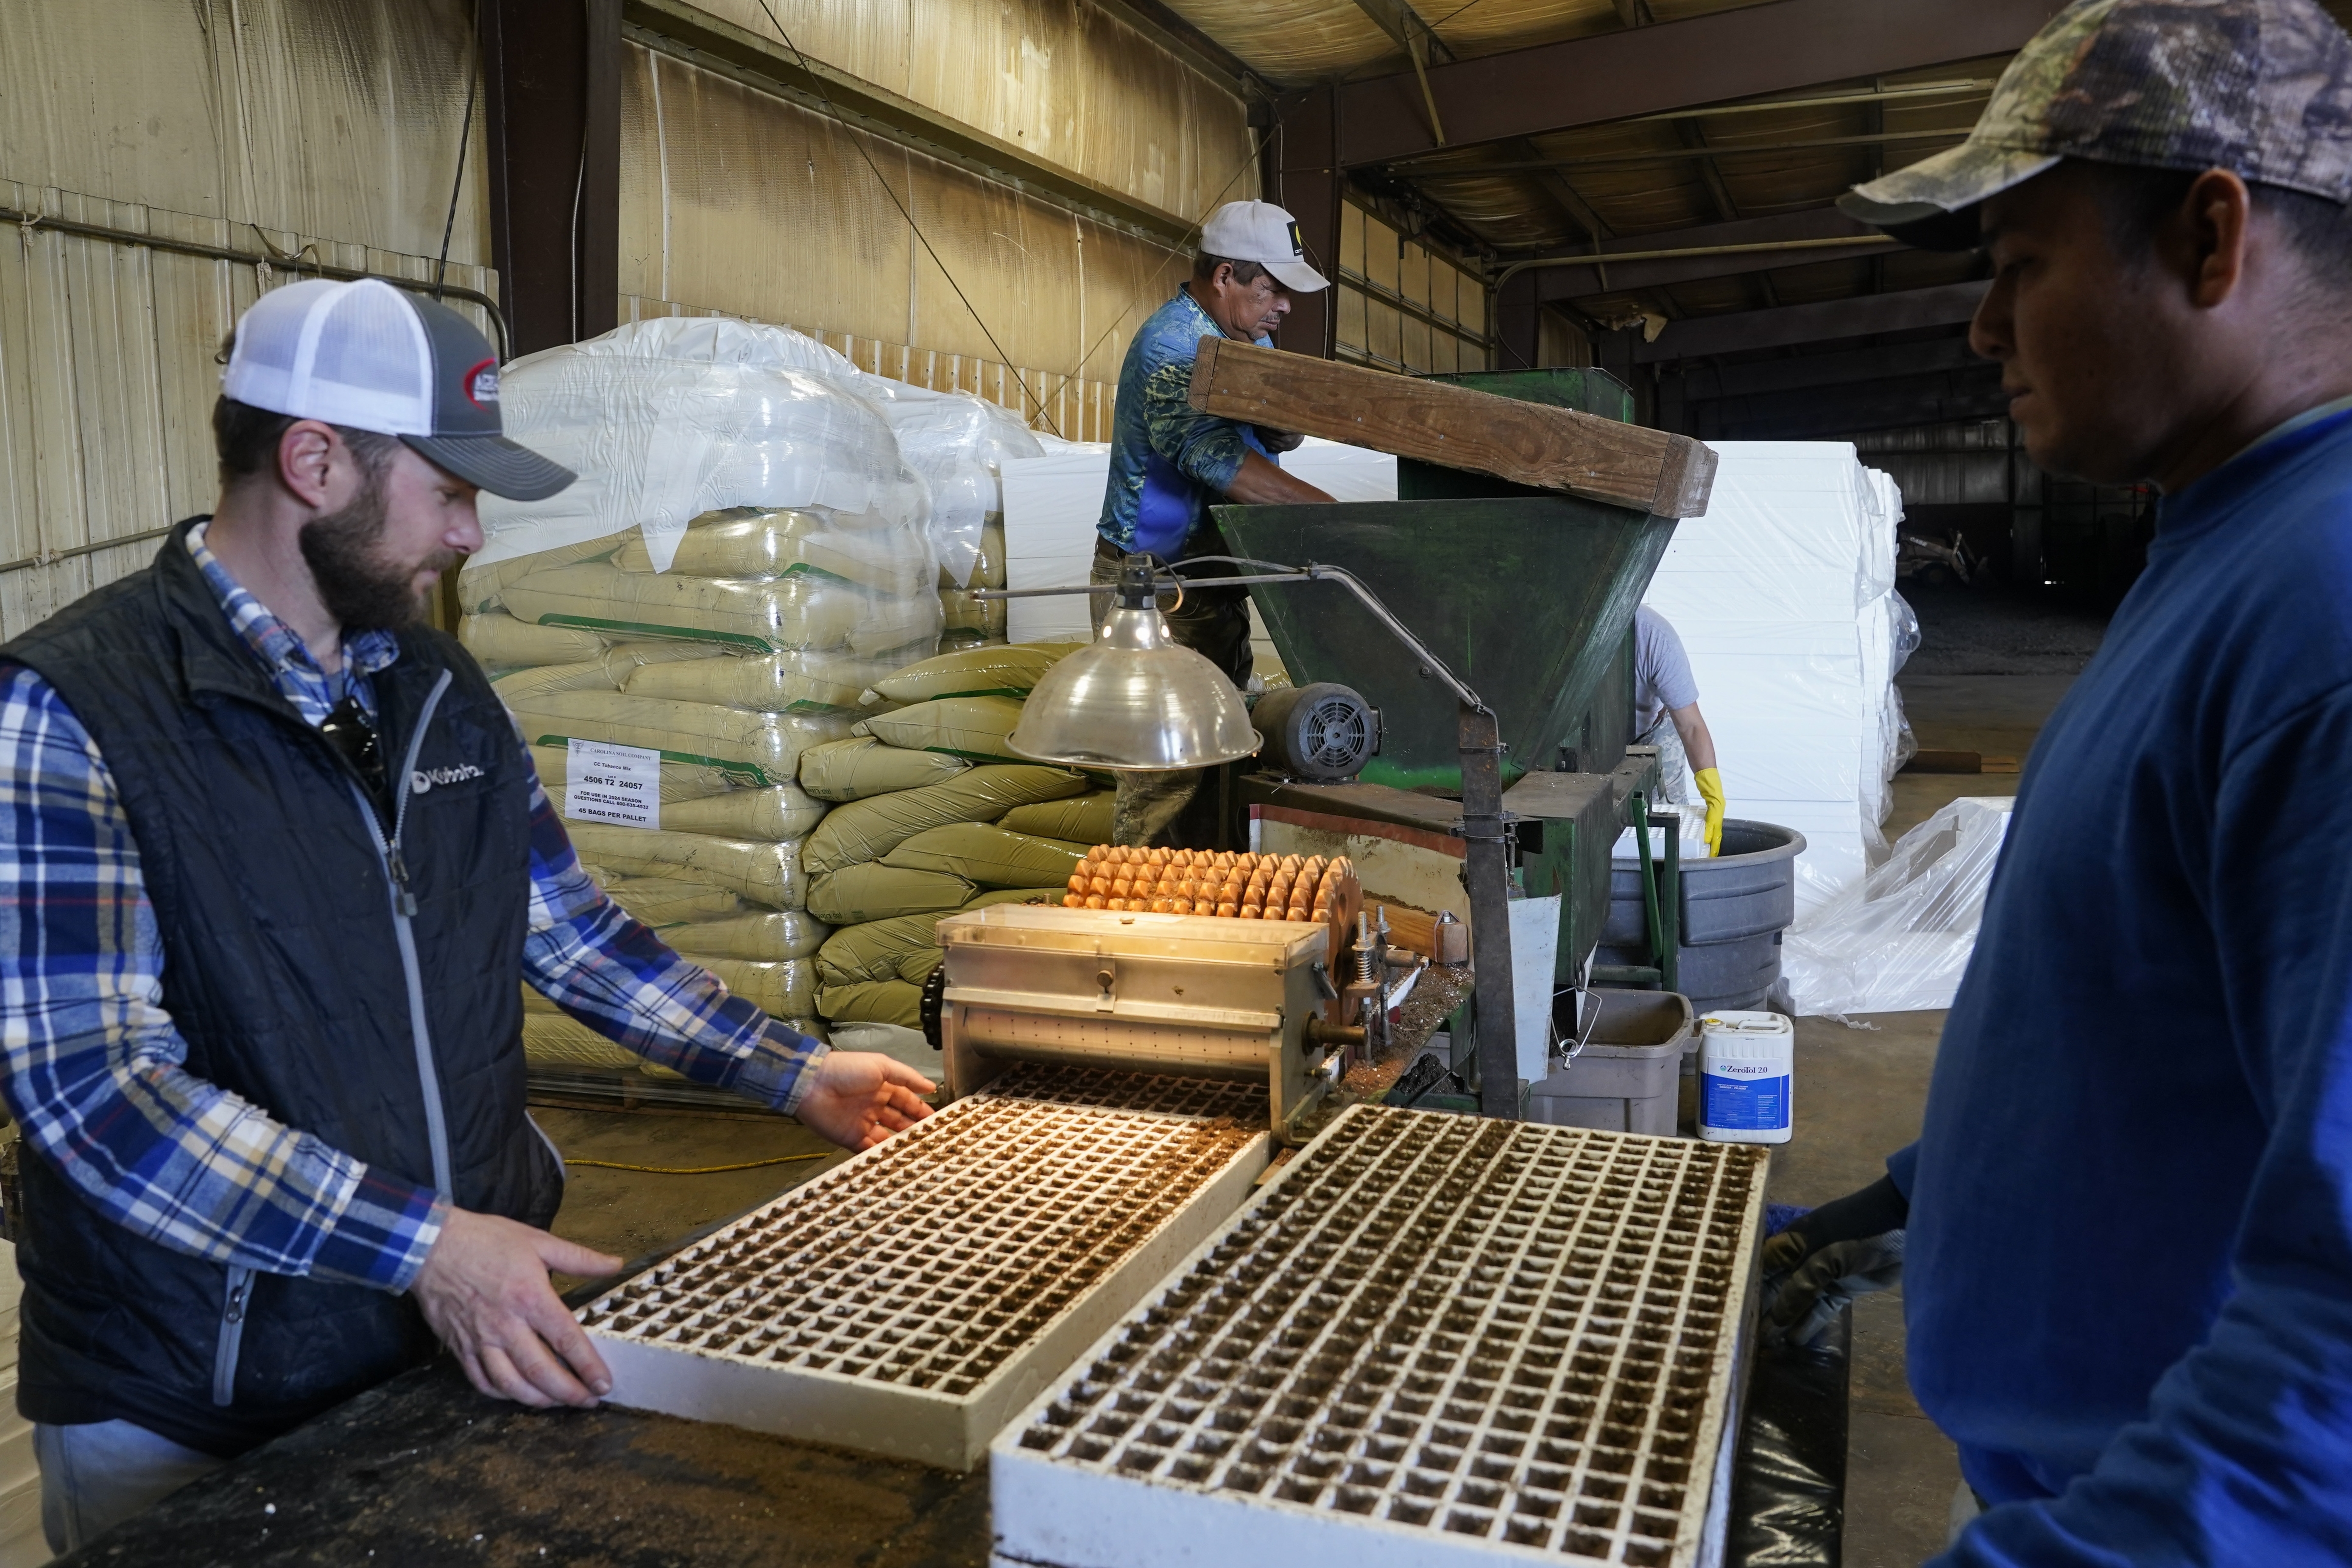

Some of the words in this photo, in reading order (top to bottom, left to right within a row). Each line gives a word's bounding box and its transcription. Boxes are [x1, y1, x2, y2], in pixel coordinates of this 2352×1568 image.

[583, 776, 603, 784] 4506
[619, 781, 643, 790] 24057
[617, 801, 649, 809] 800-635-4532
[622, 814, 647, 822] PALLET
[1727, 1065, 1755, 1073] ZeroTol
